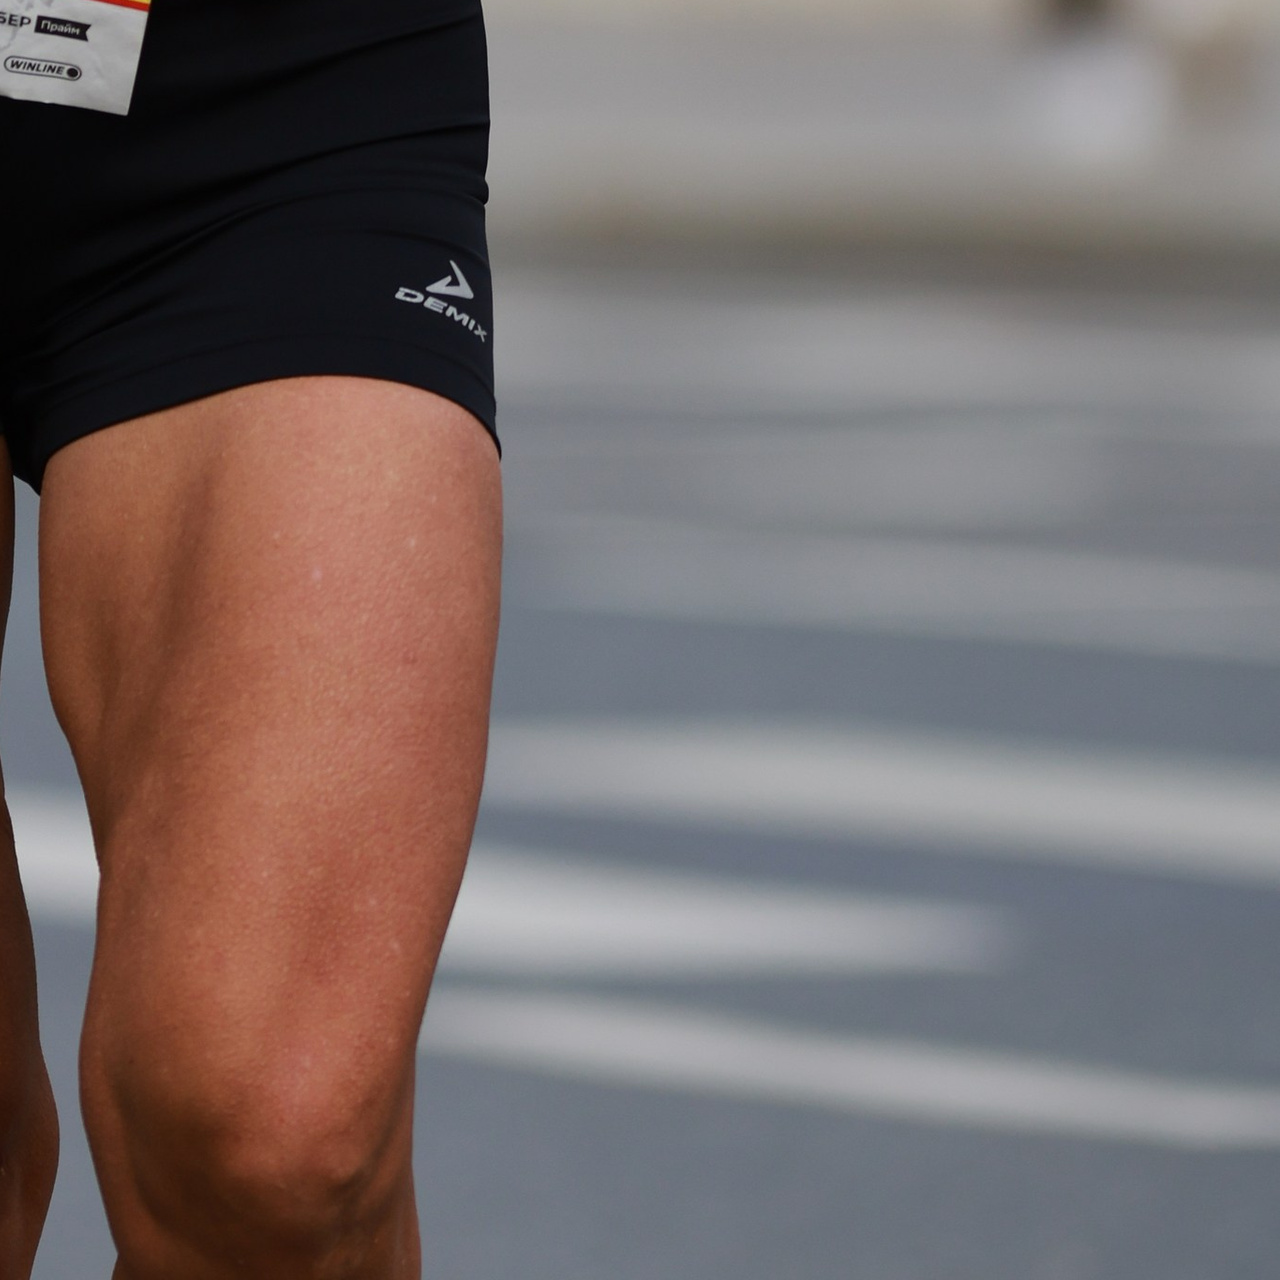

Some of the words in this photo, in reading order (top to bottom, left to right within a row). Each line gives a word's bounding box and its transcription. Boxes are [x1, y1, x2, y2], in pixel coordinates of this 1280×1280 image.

[40, 20, 81, 36] Прайм
[10, 59, 65, 75] WINLINE
[394, 287, 487, 342] DEMIX
